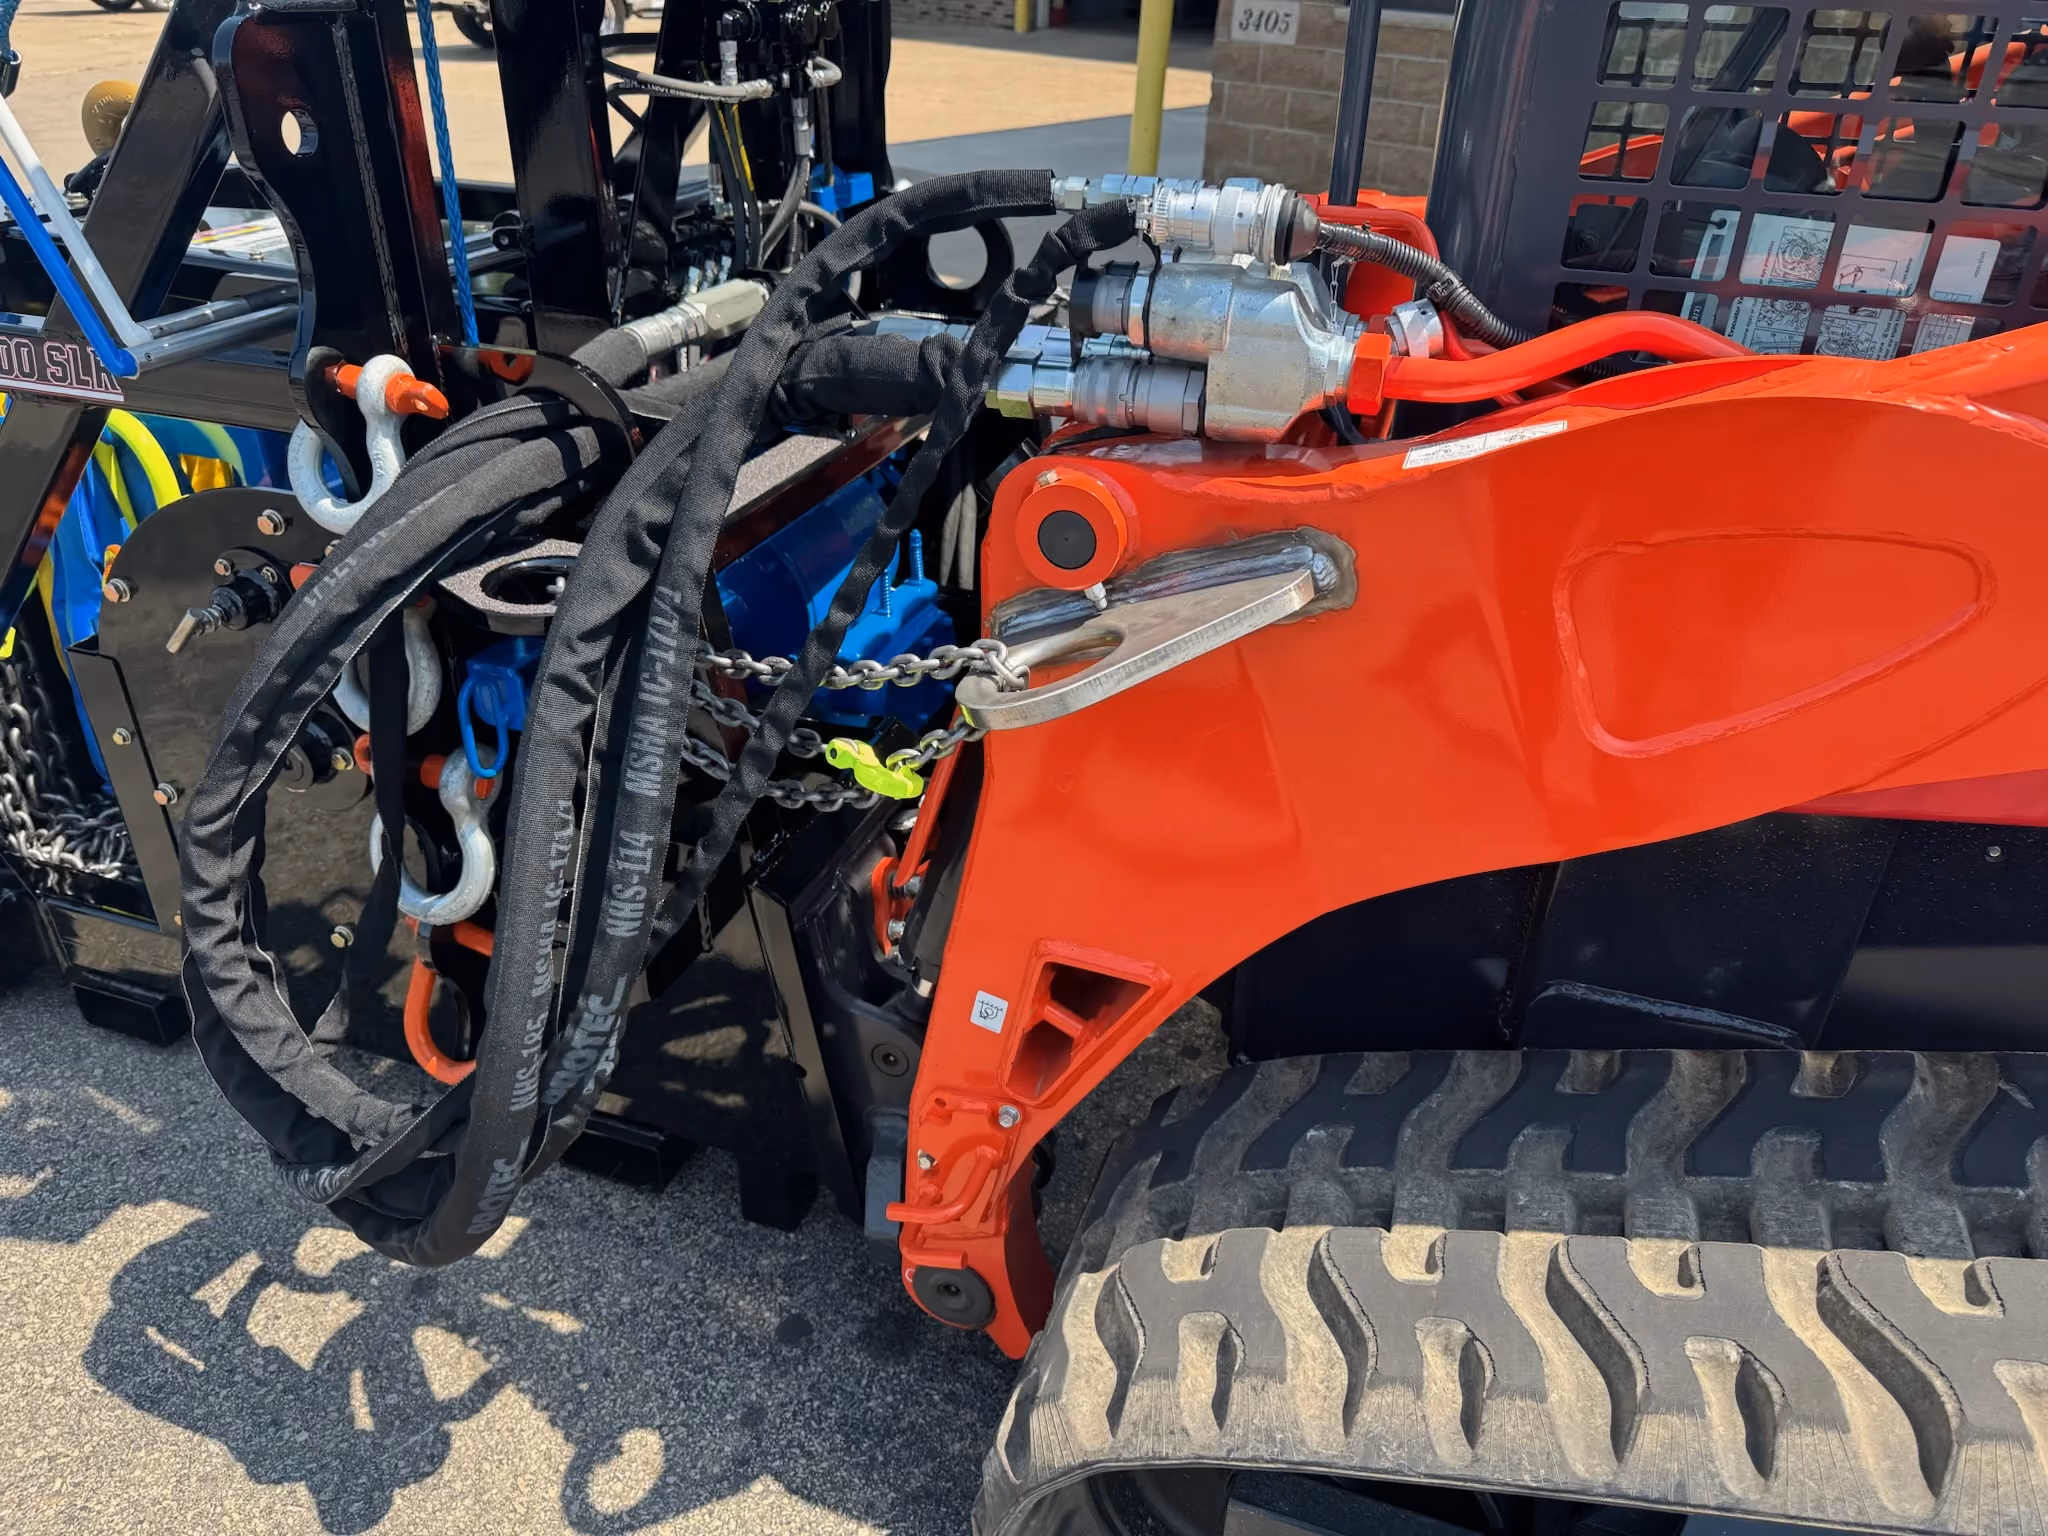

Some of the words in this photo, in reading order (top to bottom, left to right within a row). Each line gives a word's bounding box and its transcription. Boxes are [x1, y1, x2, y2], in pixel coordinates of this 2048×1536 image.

[1239, 8, 1293, 35] 3405
[639, 584, 682, 705] IC-171/1
[625, 714, 668, 797] MSHA
[605, 830, 655, 938] NHS-114
